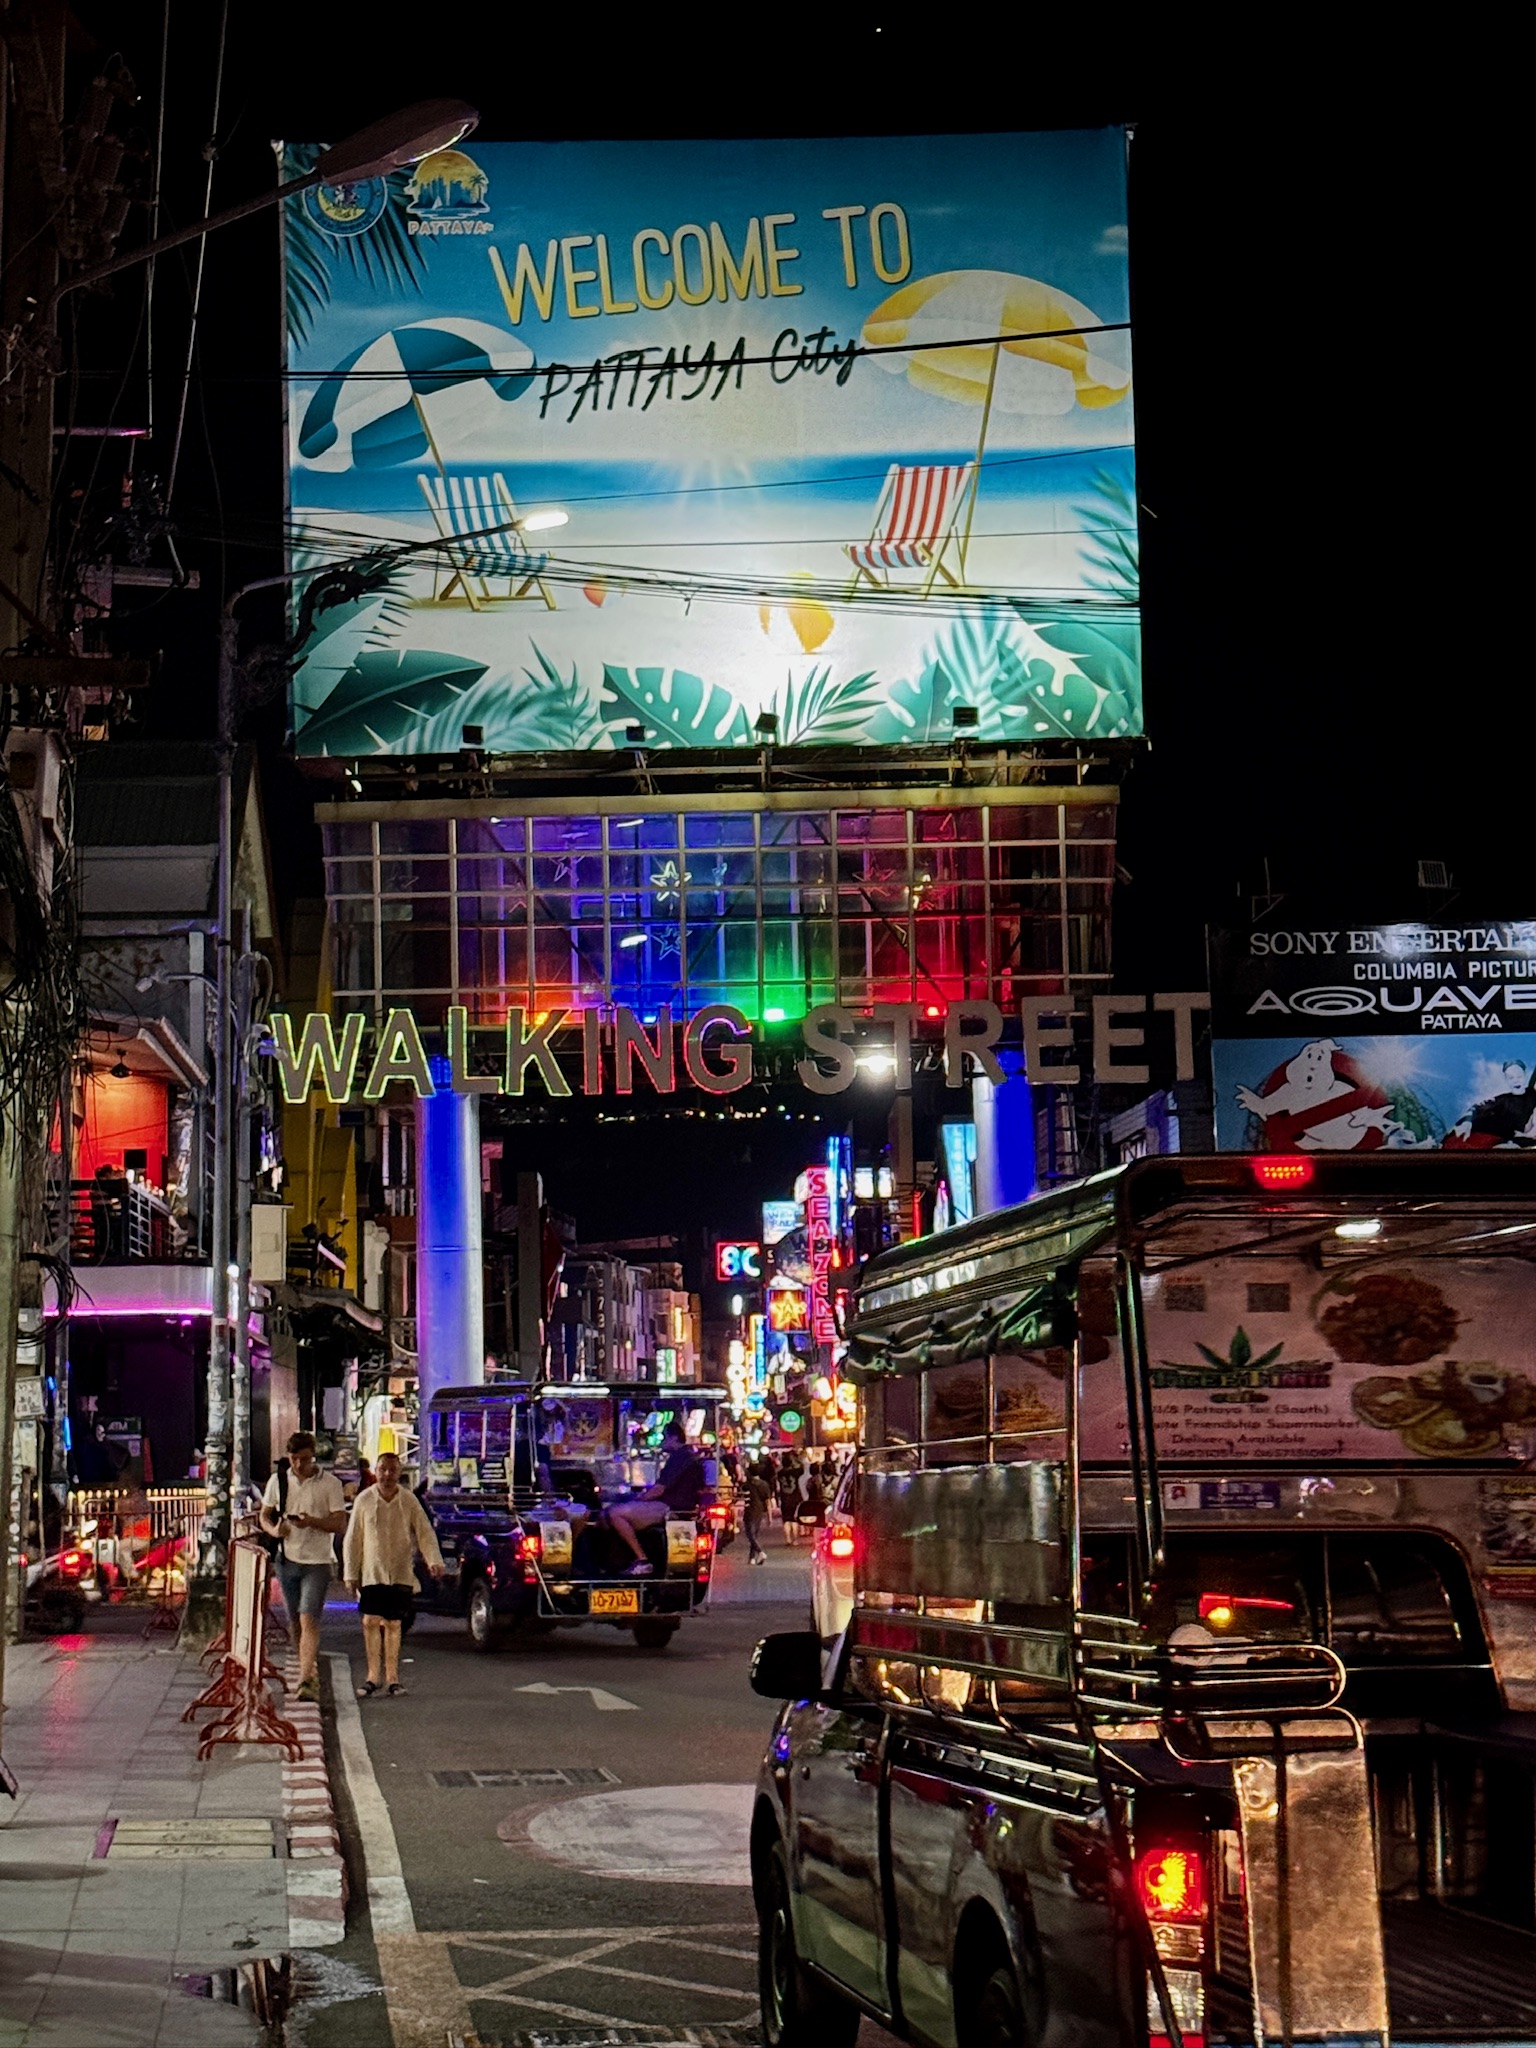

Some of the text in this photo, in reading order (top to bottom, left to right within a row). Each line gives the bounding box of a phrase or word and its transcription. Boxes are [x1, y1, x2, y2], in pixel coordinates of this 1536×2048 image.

[408, 220, 485, 236] PATTAYA
[489, 203, 911, 325] WELCOME TO
[539, 326, 863, 423] PATTAYA City
[1250, 927, 1536, 955] SONY ENERTAI
[1354, 962, 1457, 981] COLUMBIA
[1421, 1013, 1503, 1030] PATTAYA
[269, 992, 1212, 1104] WALKING STREET
